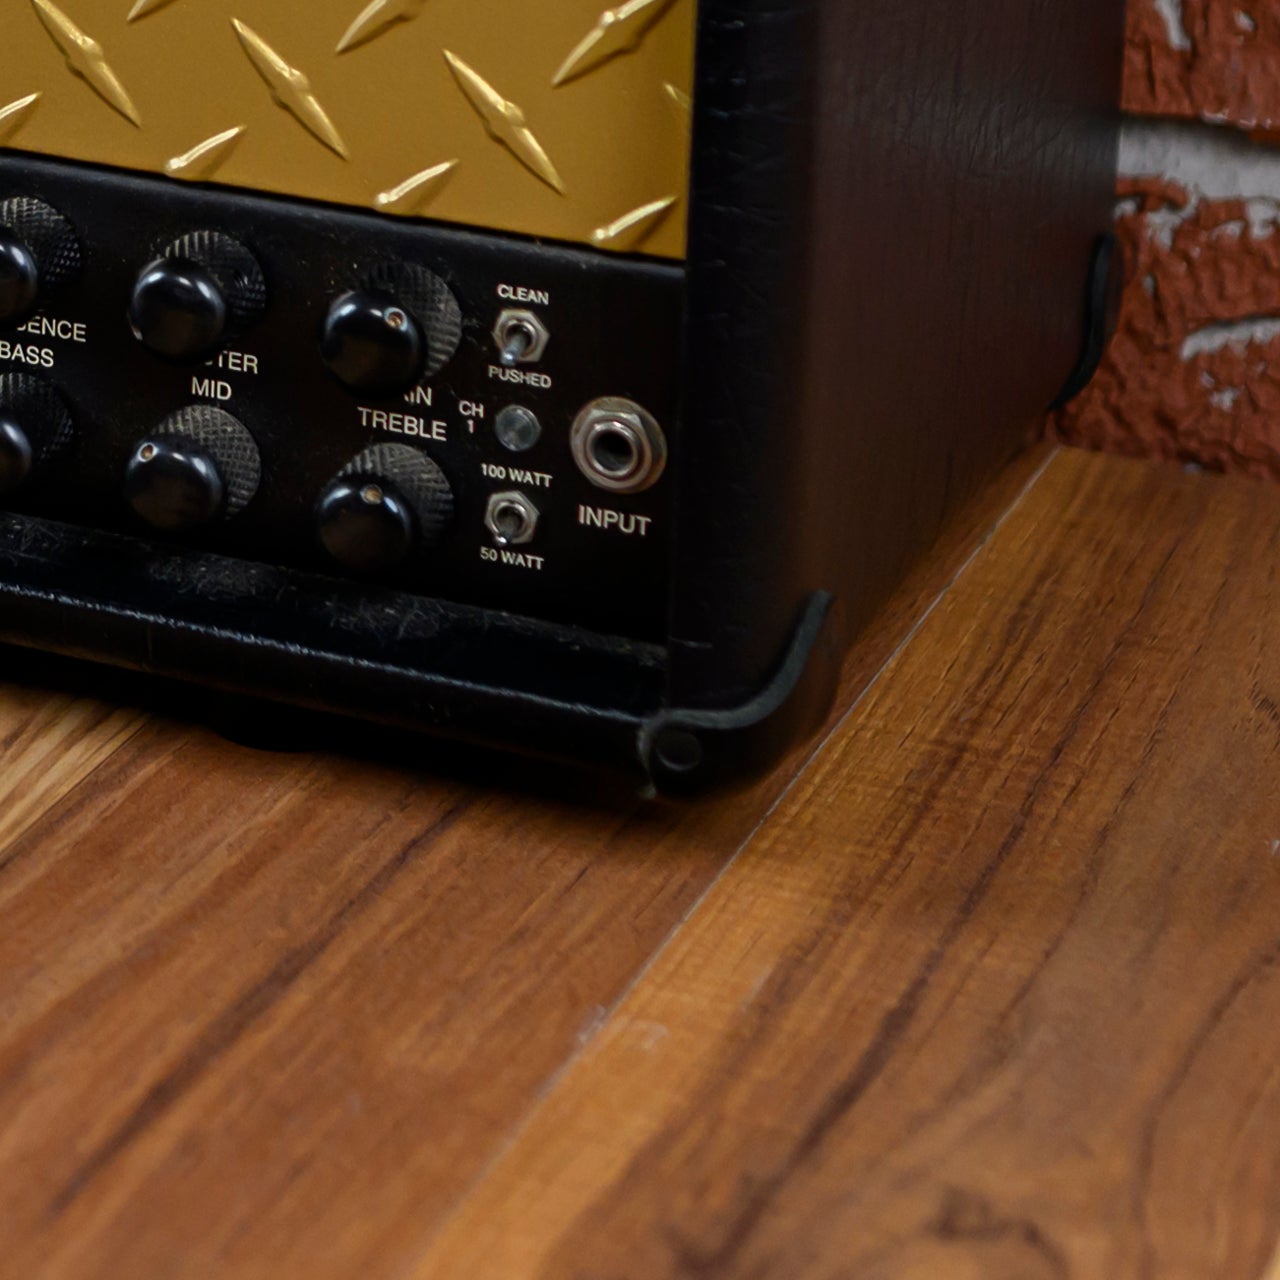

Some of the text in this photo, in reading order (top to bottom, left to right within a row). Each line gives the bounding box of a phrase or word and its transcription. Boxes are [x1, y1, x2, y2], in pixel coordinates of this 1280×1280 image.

[497, 284, 549, 306] CLEAN
[192, 376, 232, 401] MID
[488, 365, 552, 389] PUSHED
[459, 400, 484, 418] CH
[357, 406, 448, 442] TREBLE
[467, 419, 474, 434] 1
[481, 463, 553, 488] 100 WATT
[578, 504, 652, 536] INPUT
[480, 546, 544, 570] 50 WATT
